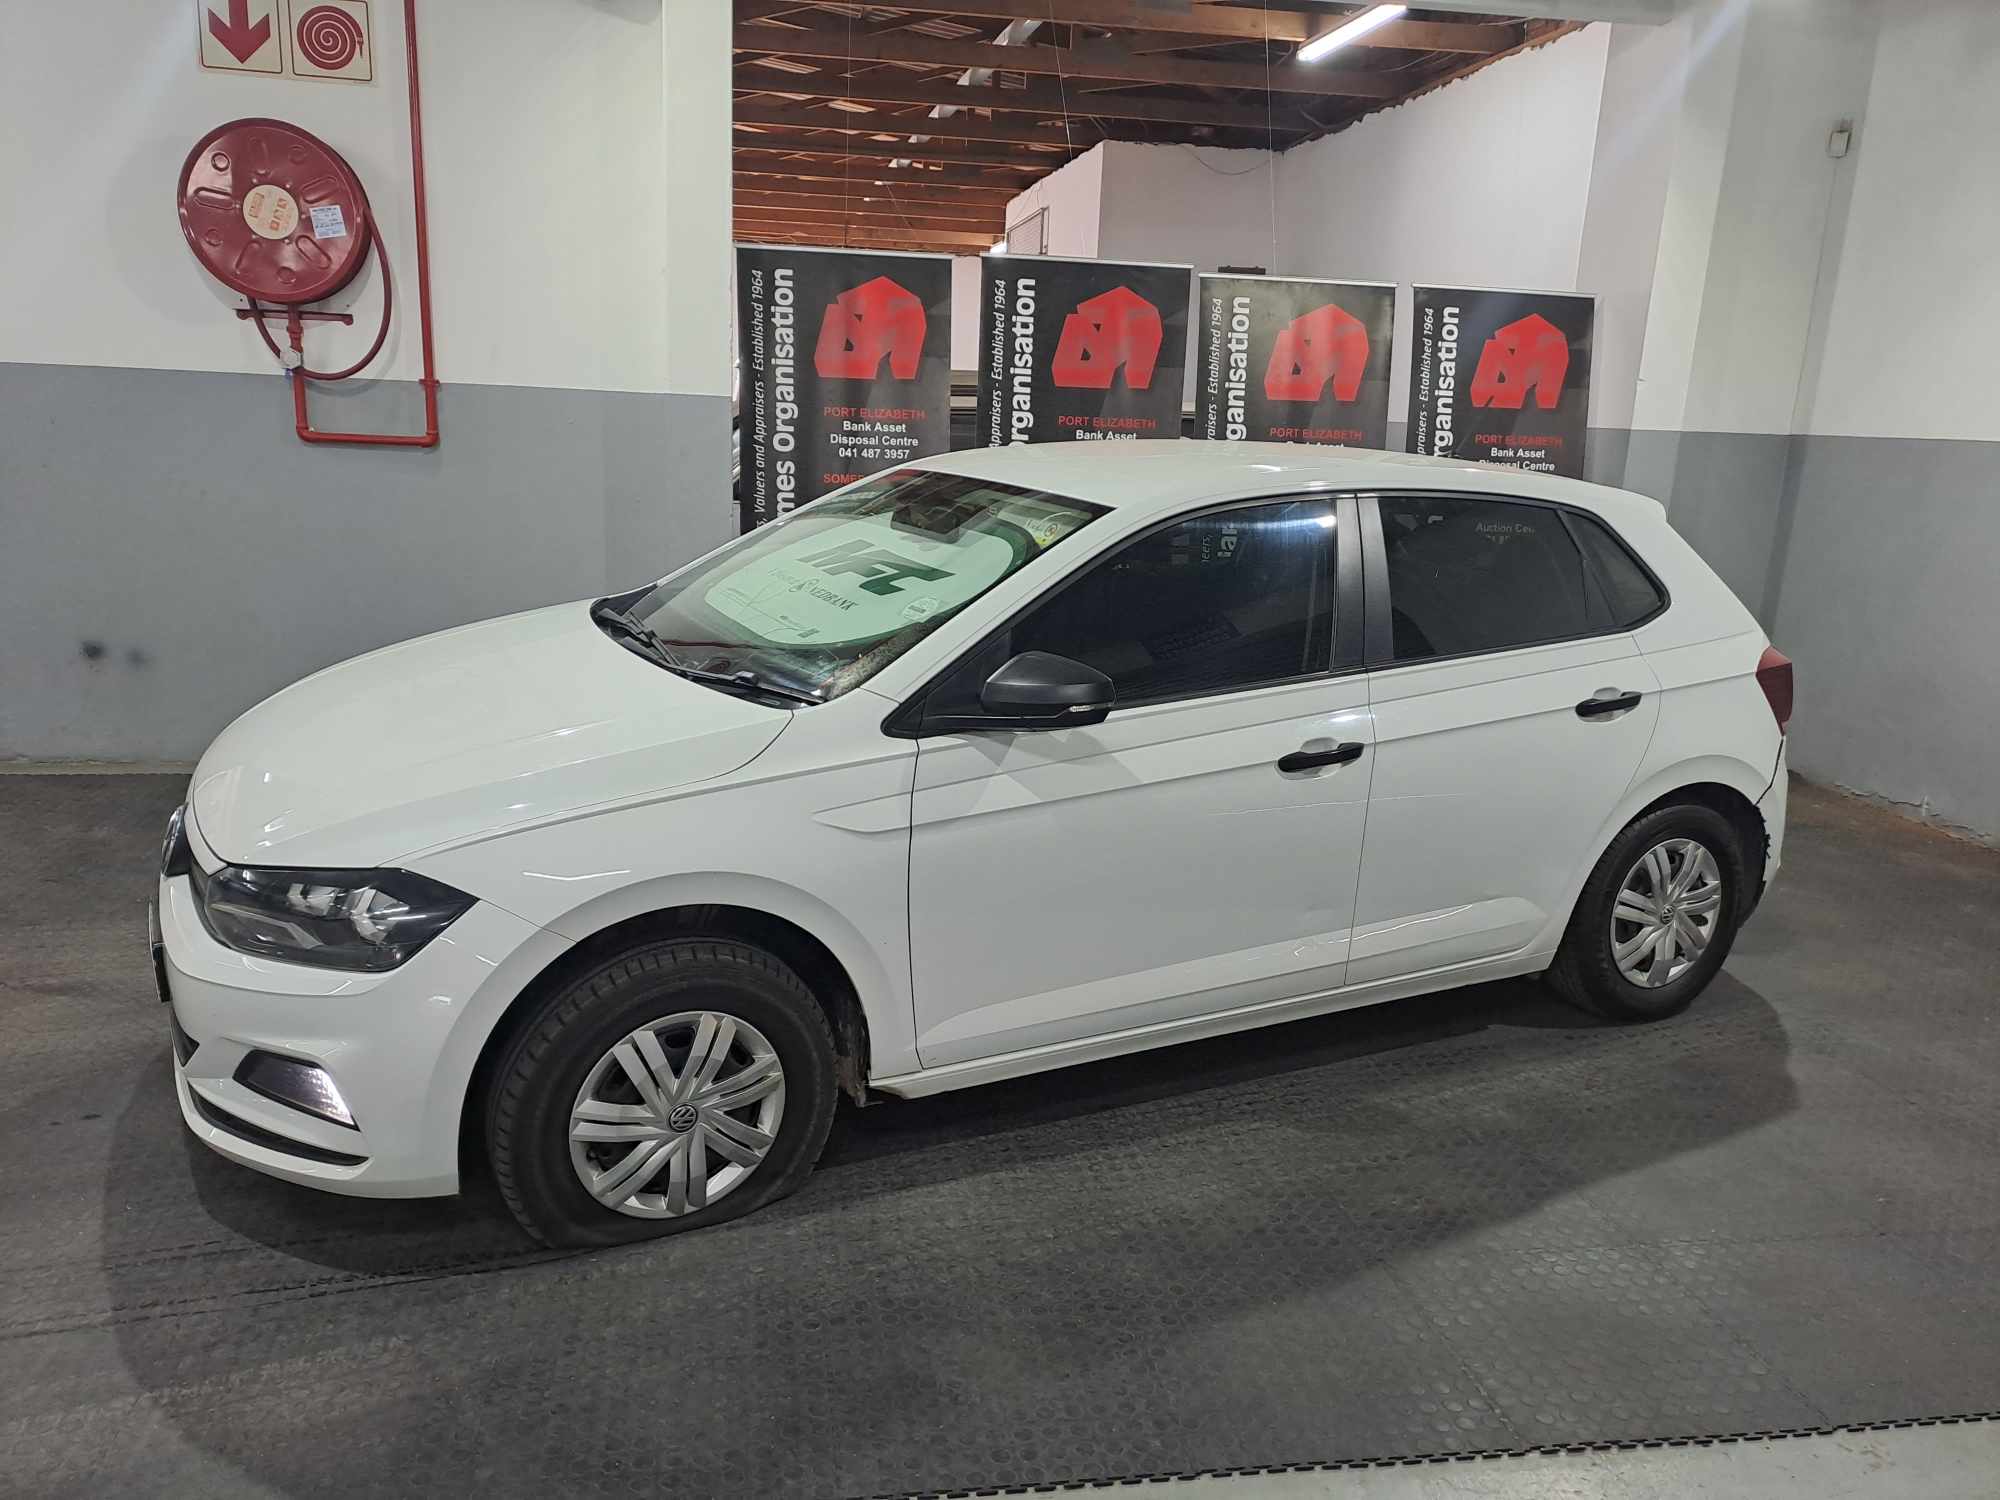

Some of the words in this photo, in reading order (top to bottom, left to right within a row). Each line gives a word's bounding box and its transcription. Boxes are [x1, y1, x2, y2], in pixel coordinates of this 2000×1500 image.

[751, 269, 764, 299] 1964
[994, 279, 1006, 310] 1964
[1212, 297, 1223, 325] 1964
[1424, 307, 1435, 335] 1964
[751, 302, 764, 371] Established
[991, 312, 1006, 380] Established
[771, 268, 799, 452] Organisation
[1207, 326, 1222, 394] Established
[1225, 296, 1251, 441] ganisation
[1418, 338, 1433, 401] Established
[752, 381, 767, 443] Appraisers
[823, 407, 856, 417] PORT
[860, 408, 927, 419] ELIZABETH
[1058, 416, 1089, 426] PORT
[1092, 417, 1156, 429] ELIZABETH
[830, 433, 879, 446] Disposal
[881, 436, 919, 447] Centre
[843, 420, 873, 431] Bank
[873, 422, 906, 433] Asset
[1076, 429, 1104, 440] Bank
[1106, 431, 1137, 440] Asset
[1270, 428, 1299, 438] PORT
[1302, 429, 1364, 440] ELIZABETH
[1416, 410, 1428, 454] praisers
[1475, 433, 1503, 444] PORT
[753, 444, 766, 469] and
[839, 447, 858, 458] 041
[861, 448, 880, 458] 487
[884, 449, 910, 459] 3957
[1490, 447, 1515, 458] Bank
[1516, 448, 1545, 459] Asset
[1522, 461, 1556, 471] Centre
[753, 471, 766, 513] Valuers
